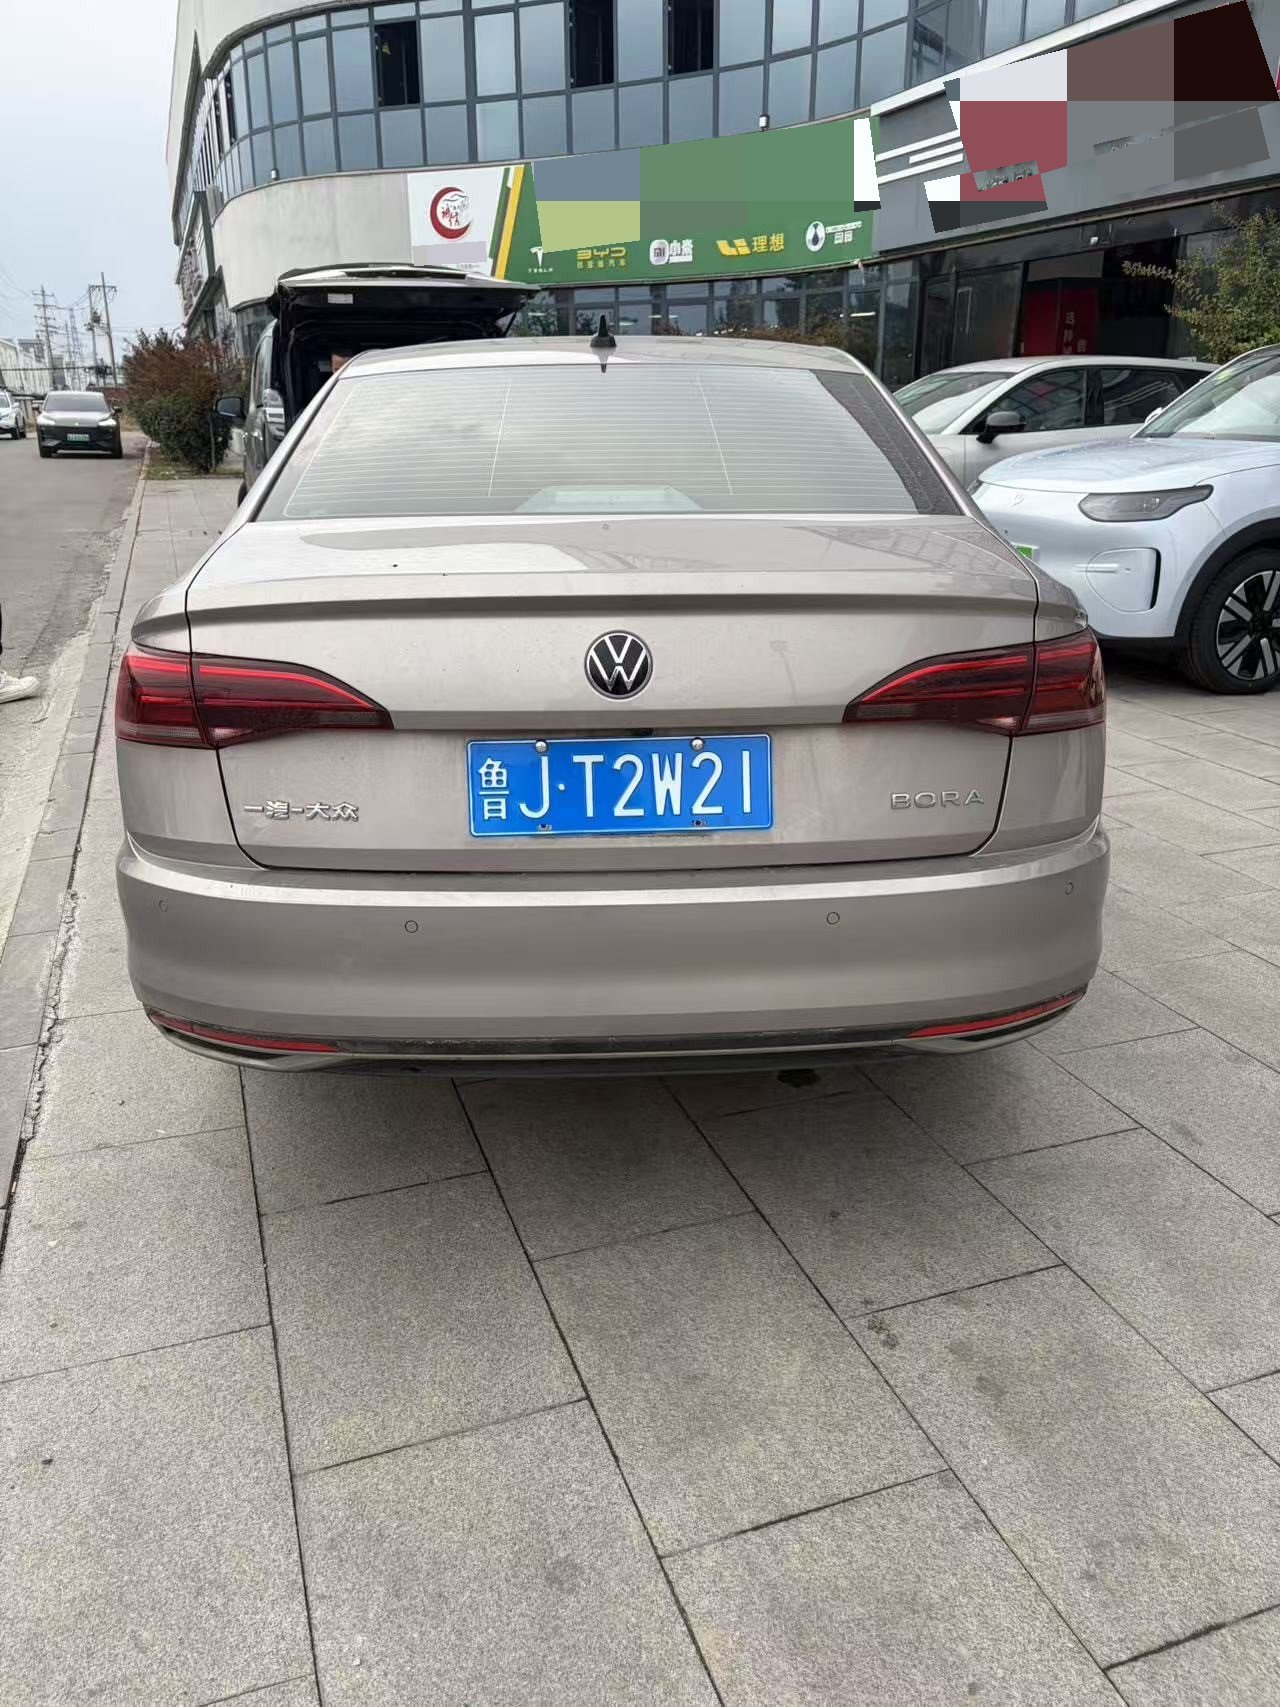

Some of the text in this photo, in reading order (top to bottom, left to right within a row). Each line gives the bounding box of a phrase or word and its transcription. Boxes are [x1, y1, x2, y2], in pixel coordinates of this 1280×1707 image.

[576, 246, 626, 260] BYD
[751, 232, 785, 253] 理想
[890, 789, 985, 810] BORA
